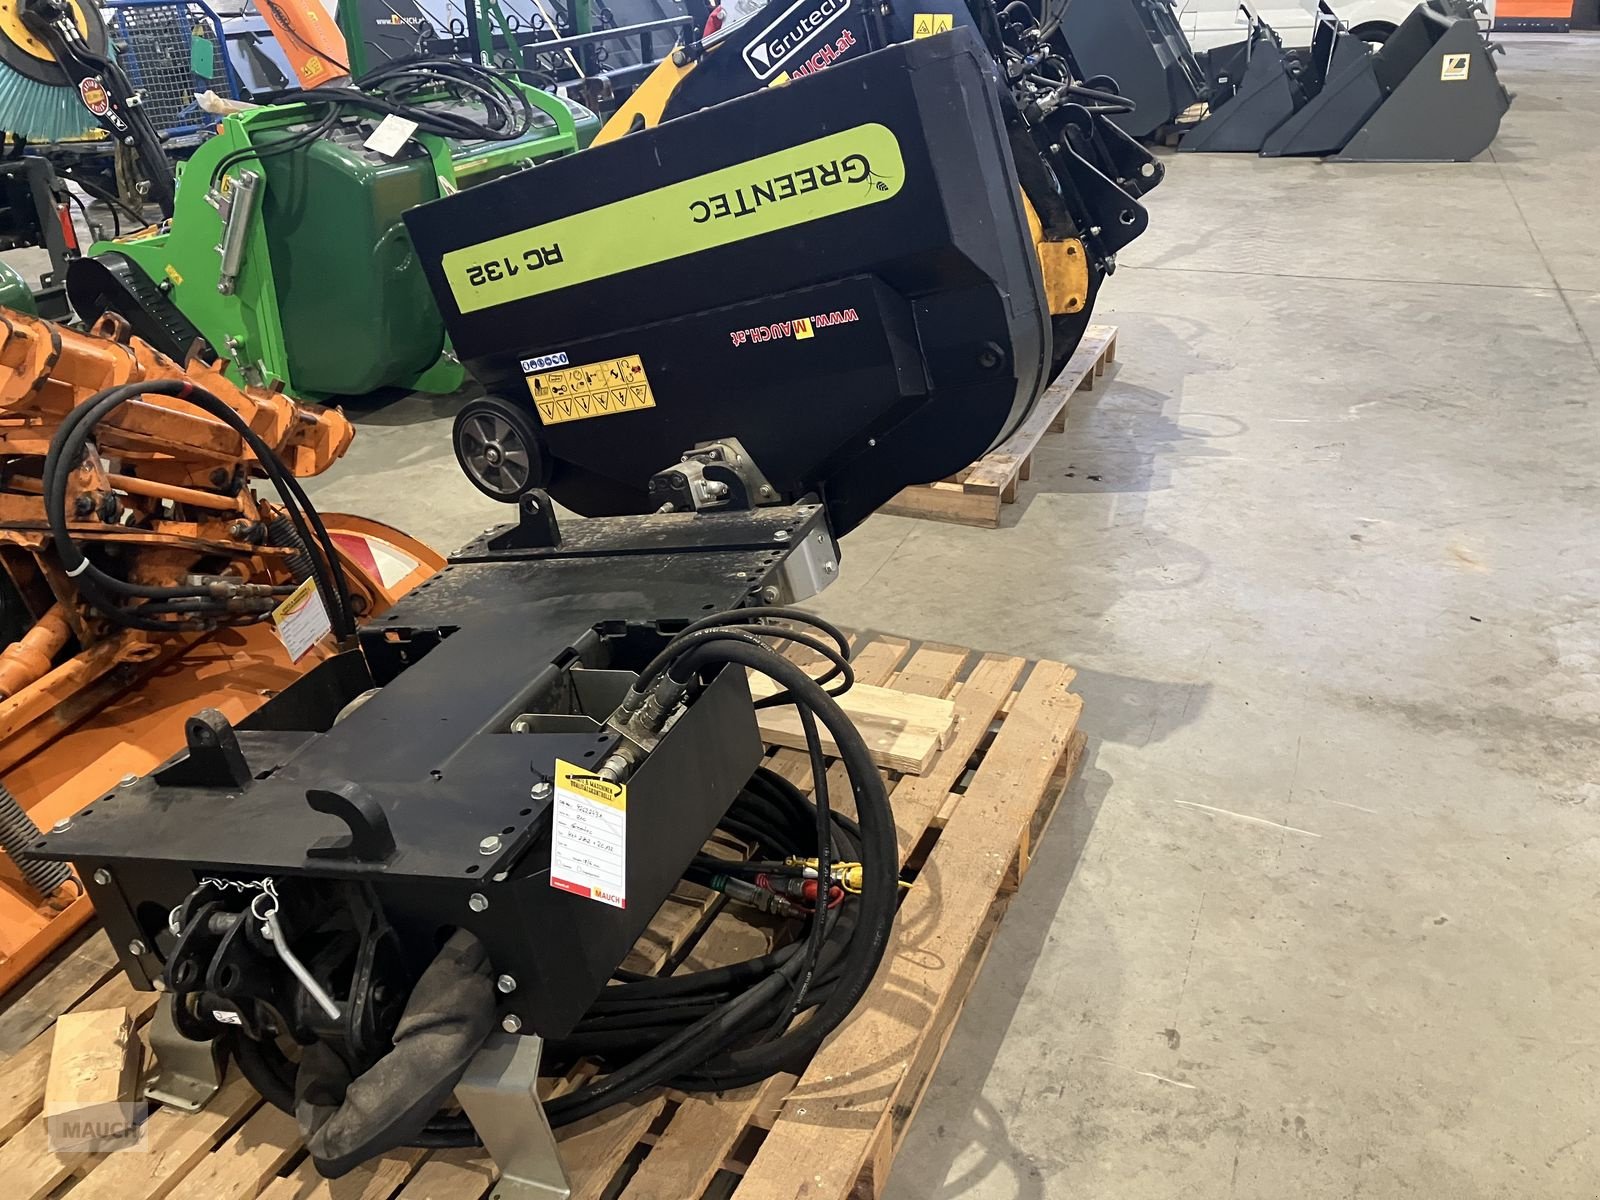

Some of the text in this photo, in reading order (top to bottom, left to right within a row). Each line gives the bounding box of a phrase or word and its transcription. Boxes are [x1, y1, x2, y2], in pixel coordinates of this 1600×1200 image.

[466, 243, 563, 286] RC 132
[730, 308, 859, 347] www.MAUCH.at
[594, 889, 620, 904] MAUCH
